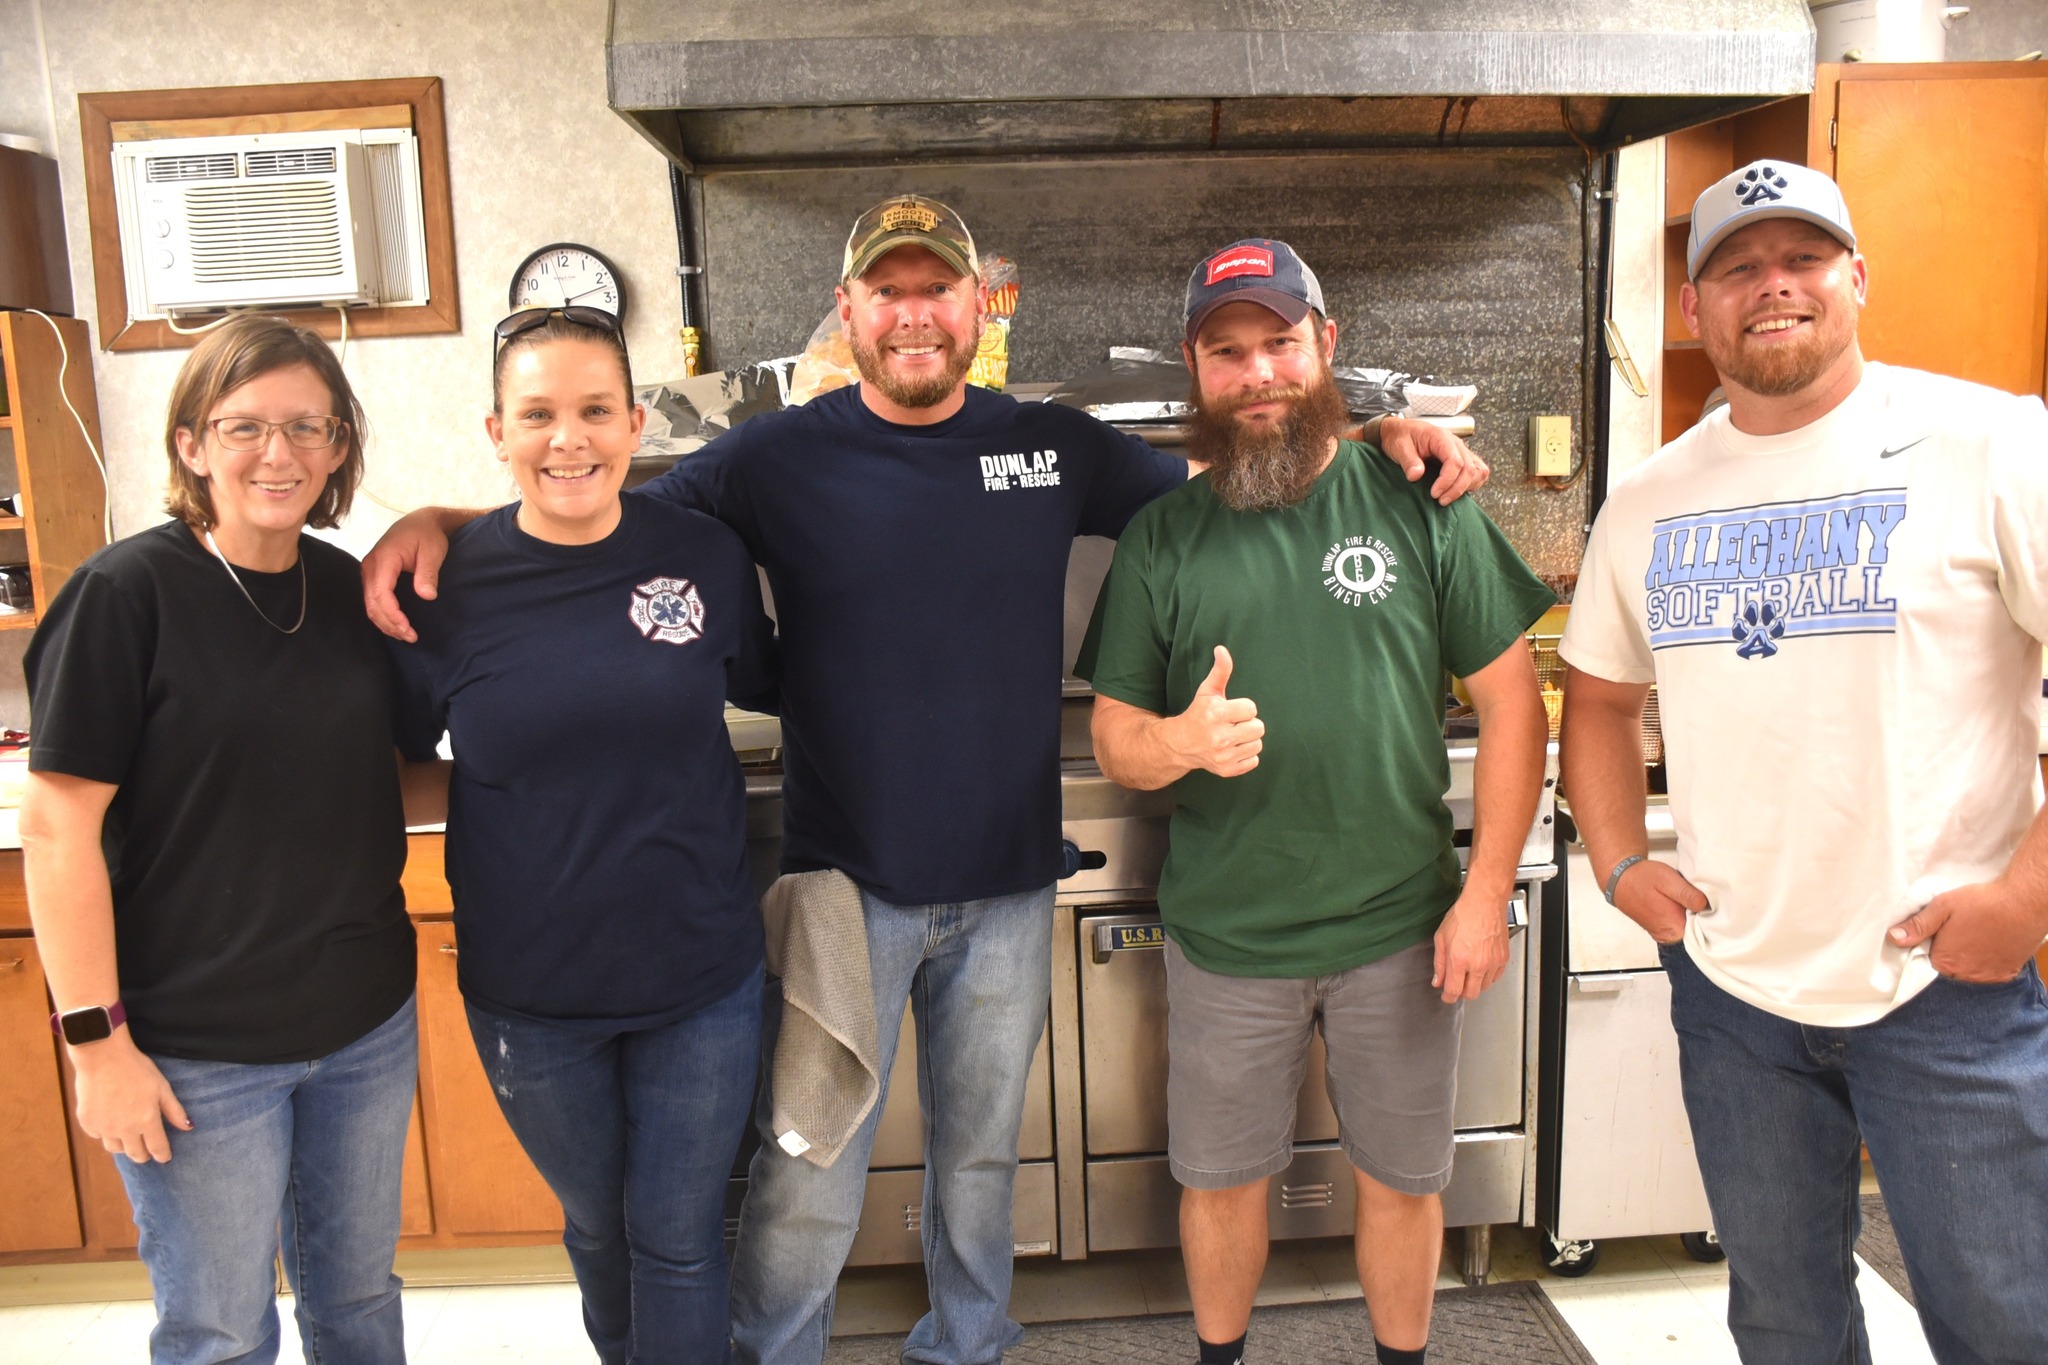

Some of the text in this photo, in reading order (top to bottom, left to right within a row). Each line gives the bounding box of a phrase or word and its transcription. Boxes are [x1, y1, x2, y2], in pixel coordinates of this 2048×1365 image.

[886, 209, 931, 218] SMOOTH
[886, 215, 931, 223] AMBLER
[557, 255, 569, 267] 12
[581, 259, 586, 271] 1
[541, 263, 549, 275] 11
[595, 272, 604, 284] 2
[527, 279, 539, 291] 10
[603, 291, 612, 303] 3
[979, 449, 1058, 478] DUNLAP
[984, 476, 1010, 492] FIRE
[1020, 471, 1061, 488] RESCUE
[1645, 504, 1906, 590] ALLEGHANY
[1321, 543, 1341, 572] DUNLAP
[1345, 535, 1364, 547] FIRE
[1373, 539, 1398, 568] RESCUE
[1323, 572, 1398, 607] BINGO CREW
[1646, 566, 1897, 631] SOFTBALL
